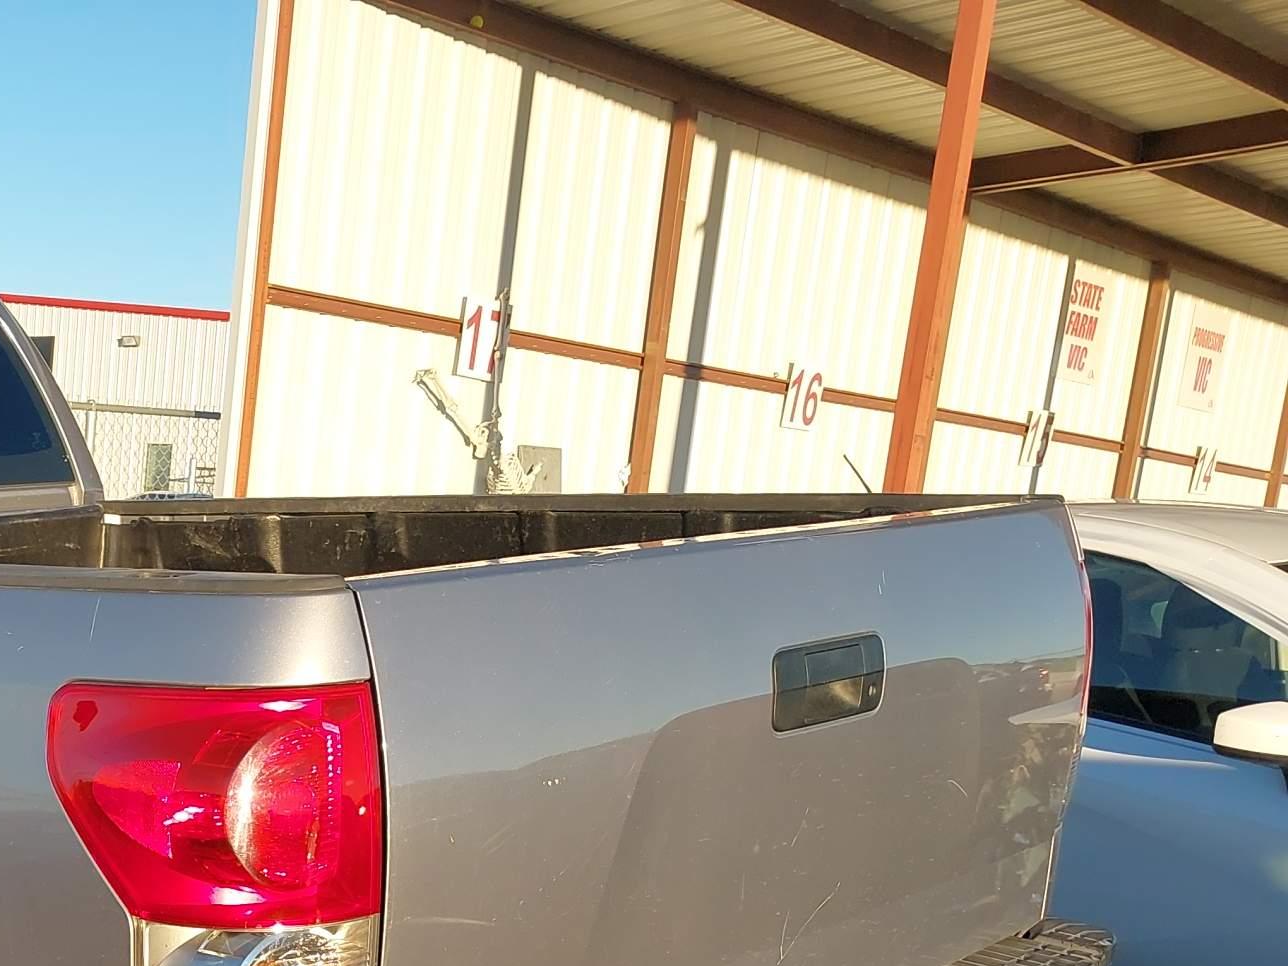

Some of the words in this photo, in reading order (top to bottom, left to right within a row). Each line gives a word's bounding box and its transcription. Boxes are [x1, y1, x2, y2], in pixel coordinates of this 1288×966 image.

[1070, 279, 1104, 311] STATE
[1065, 310, 1098, 341] FARM
[1067, 344, 1087, 371] VIC
[1193, 356, 1212, 393] VIC
[791, 368, 823, 426] 16
[1194, 447, 1218, 492] 14
